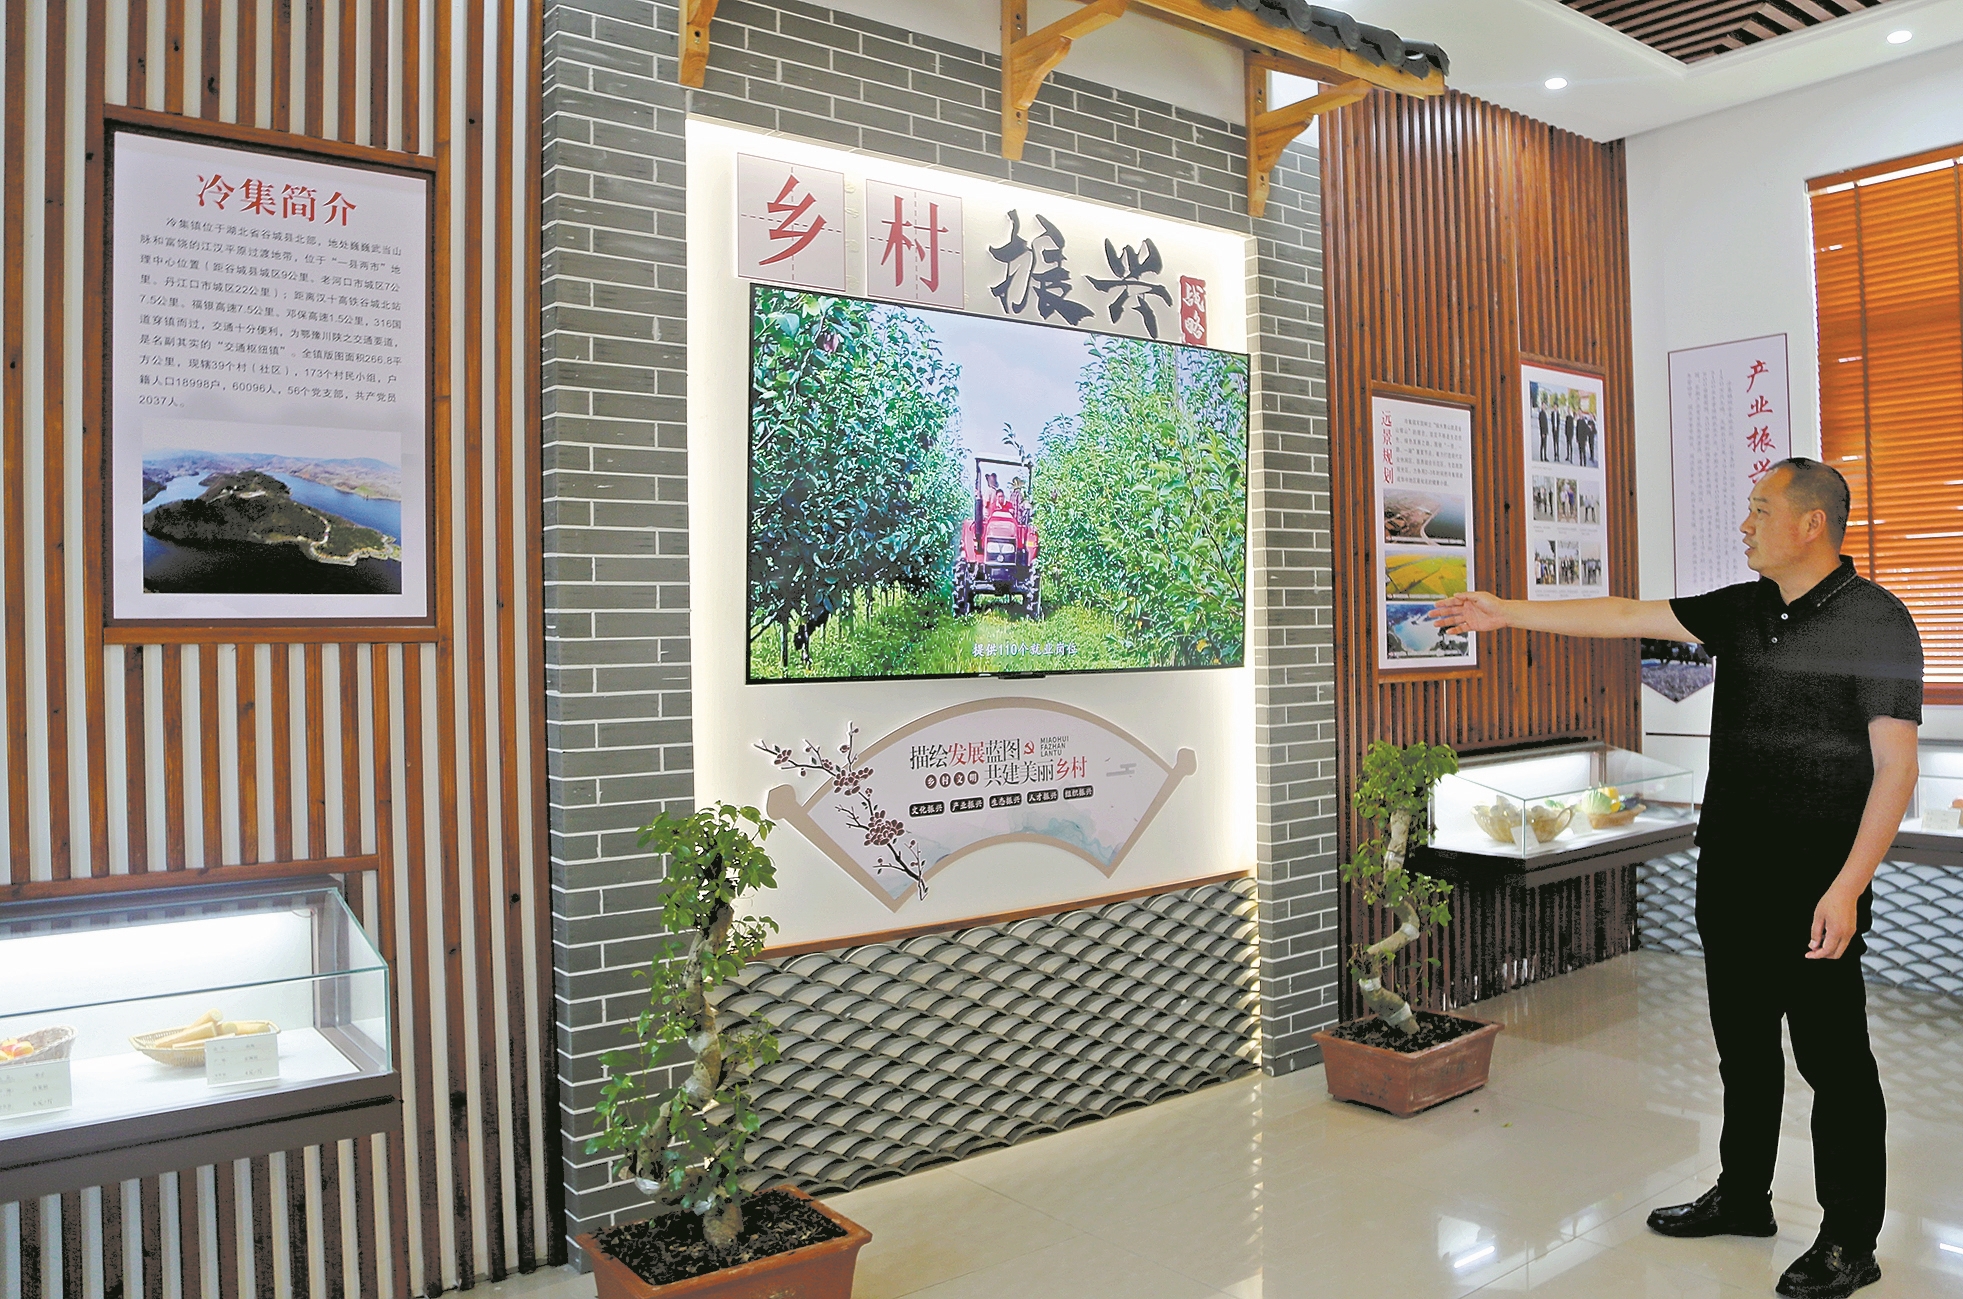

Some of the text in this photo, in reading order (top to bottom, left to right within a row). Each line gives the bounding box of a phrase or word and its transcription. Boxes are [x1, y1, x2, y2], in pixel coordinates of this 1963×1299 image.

[196, 174, 357, 227] 冷集简介
[758, 174, 1173, 340] 乡村振兴
[1381, 411, 1394, 484] 远景规划
[972, 642, 1078, 657] 提供110个就业岗位
[909, 738, 1021, 770] 描绘发展蓝图
[926, 771, 978, 788] 乡村文明
[984, 756, 1088, 788] 共建美丽乡村
[911, 803, 943, 815] 文化振兴
[951, 799, 983, 812] 产业振兴
[1028, 791, 1058, 802] 人才振兴
